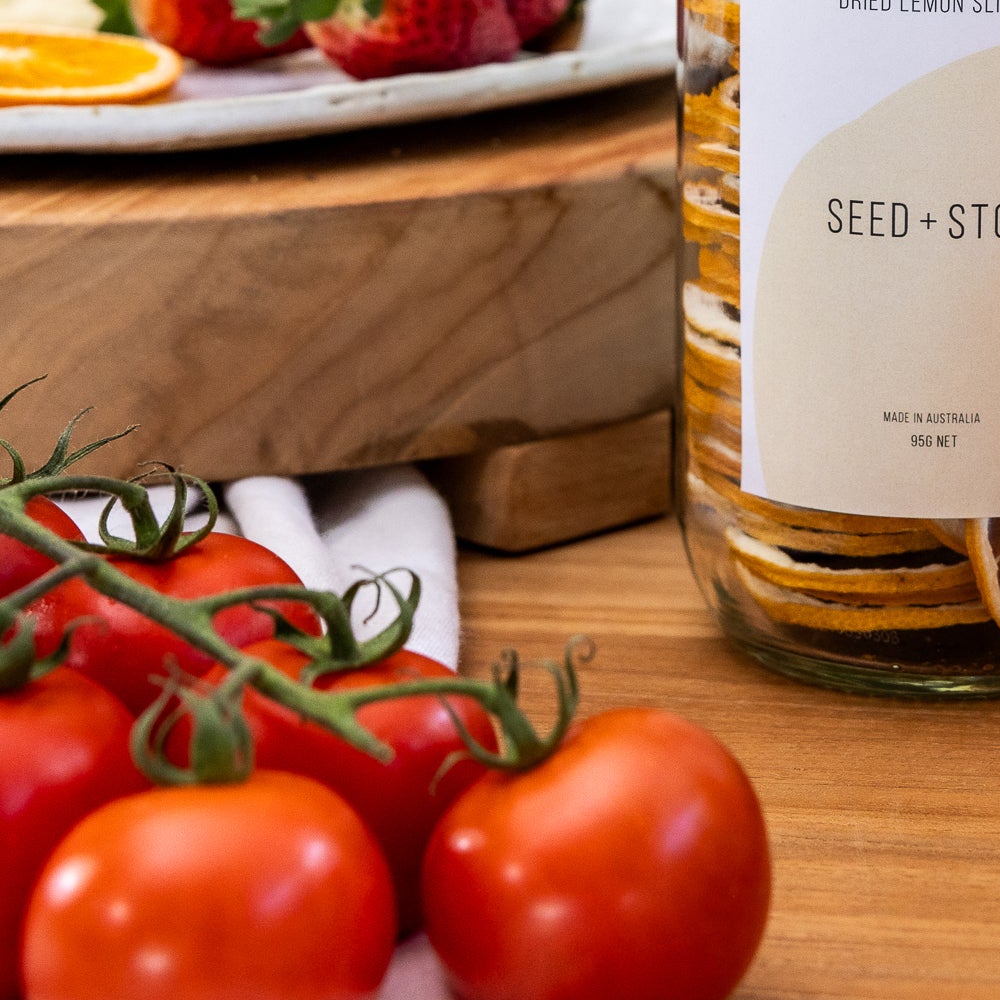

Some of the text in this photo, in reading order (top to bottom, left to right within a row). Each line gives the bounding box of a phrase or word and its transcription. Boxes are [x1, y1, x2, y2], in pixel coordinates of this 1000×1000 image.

[827, 197, 909, 238] SEED
[919, 212, 938, 230] +
[883, 411, 981, 425] MADE IN AUSTRALIA
[910, 434, 958, 448] 95G NET
